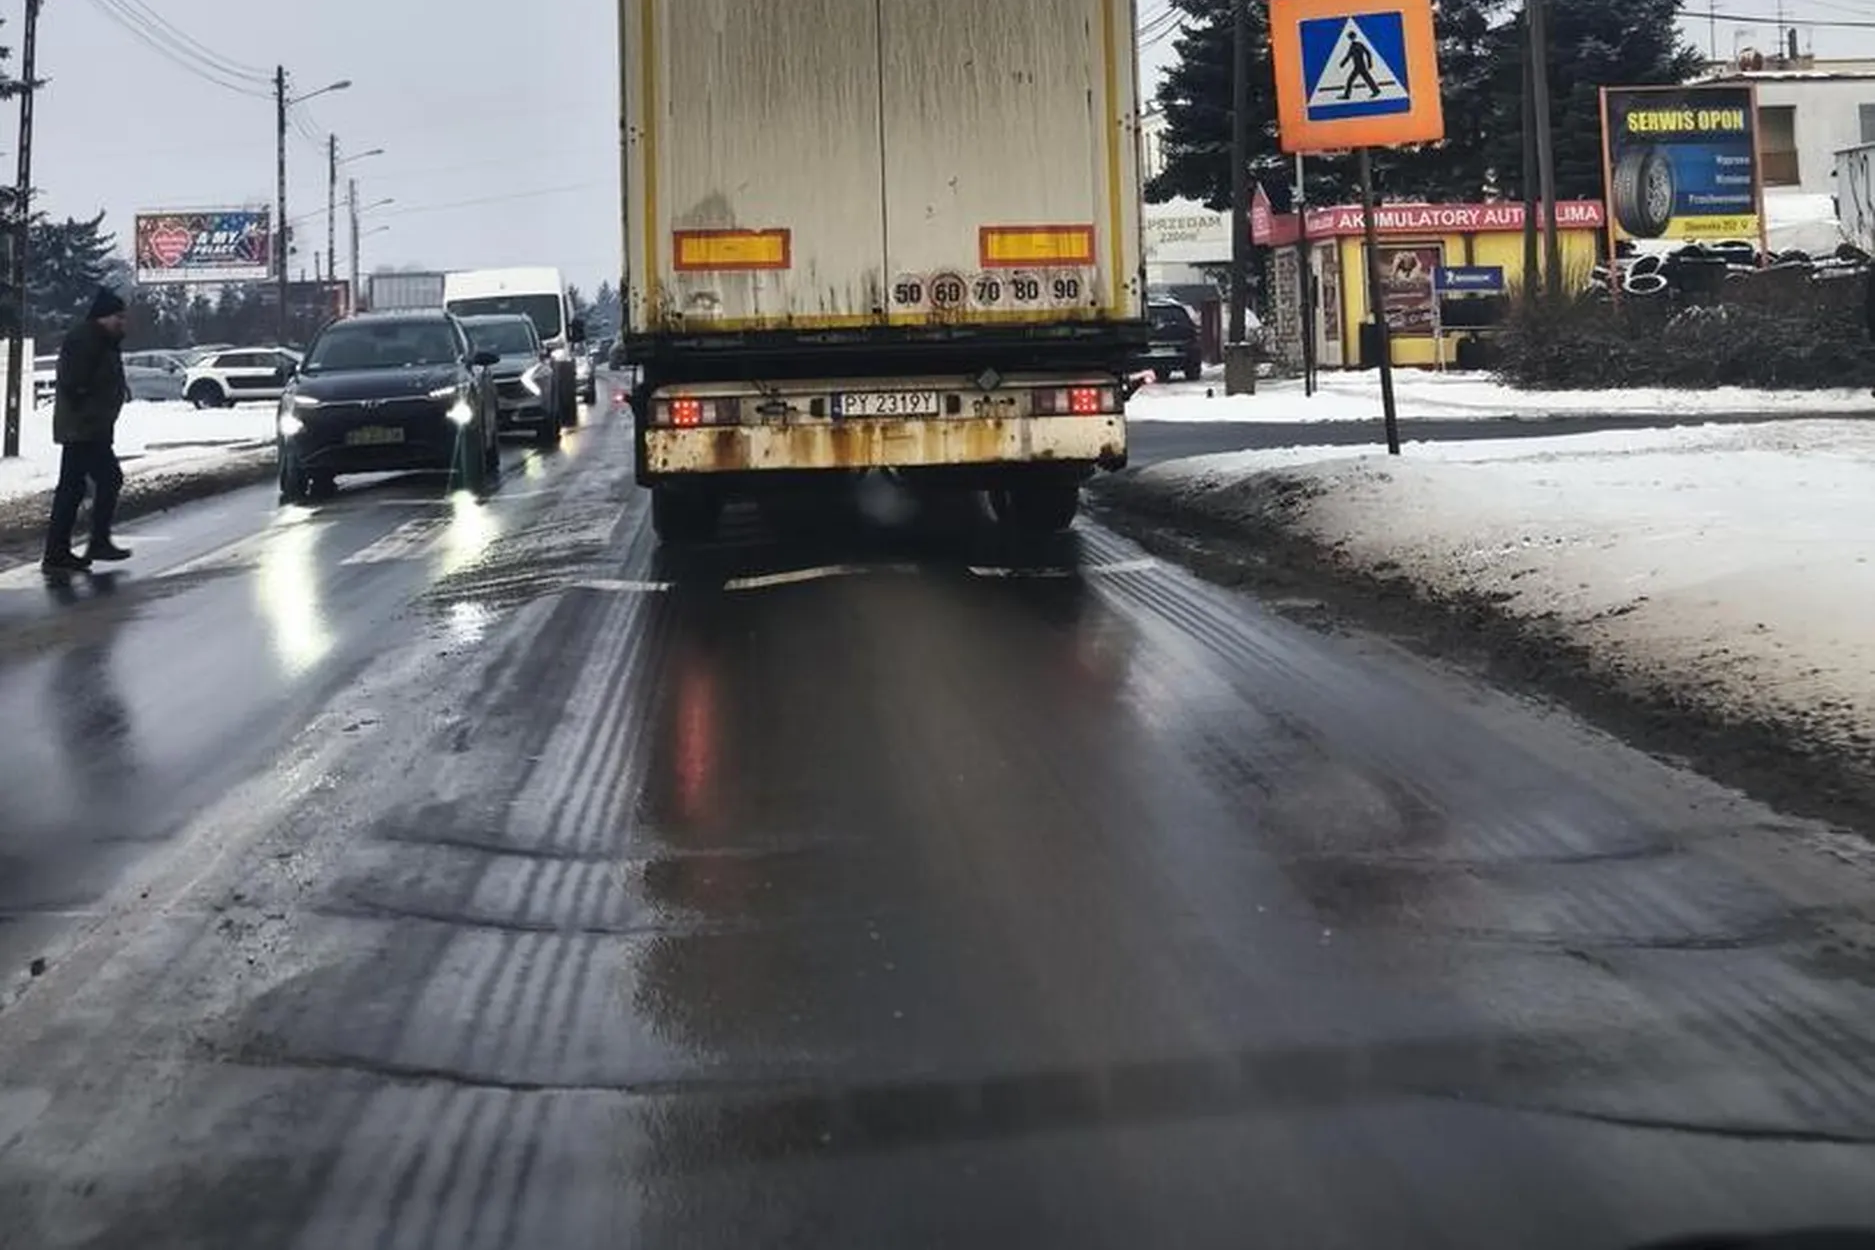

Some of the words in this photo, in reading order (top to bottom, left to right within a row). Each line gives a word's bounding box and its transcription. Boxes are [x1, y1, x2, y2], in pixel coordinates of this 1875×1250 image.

[1626, 110, 1695, 132] SERWIS
[1697, 109, 1745, 130] OPON
[1147, 216, 1221, 230] PRZEDAM
[1338, 209, 1480, 228] AKMULATORY
[895, 283, 922, 304] 50
[934, 281, 960, 302] 60
[976, 281, 1000, 302] 70
[1014, 279, 1038, 300] 80
[1053, 278, 1078, 299] 90
[844, 393, 868, 413] PY
[876, 392, 932, 413] 2319Y
